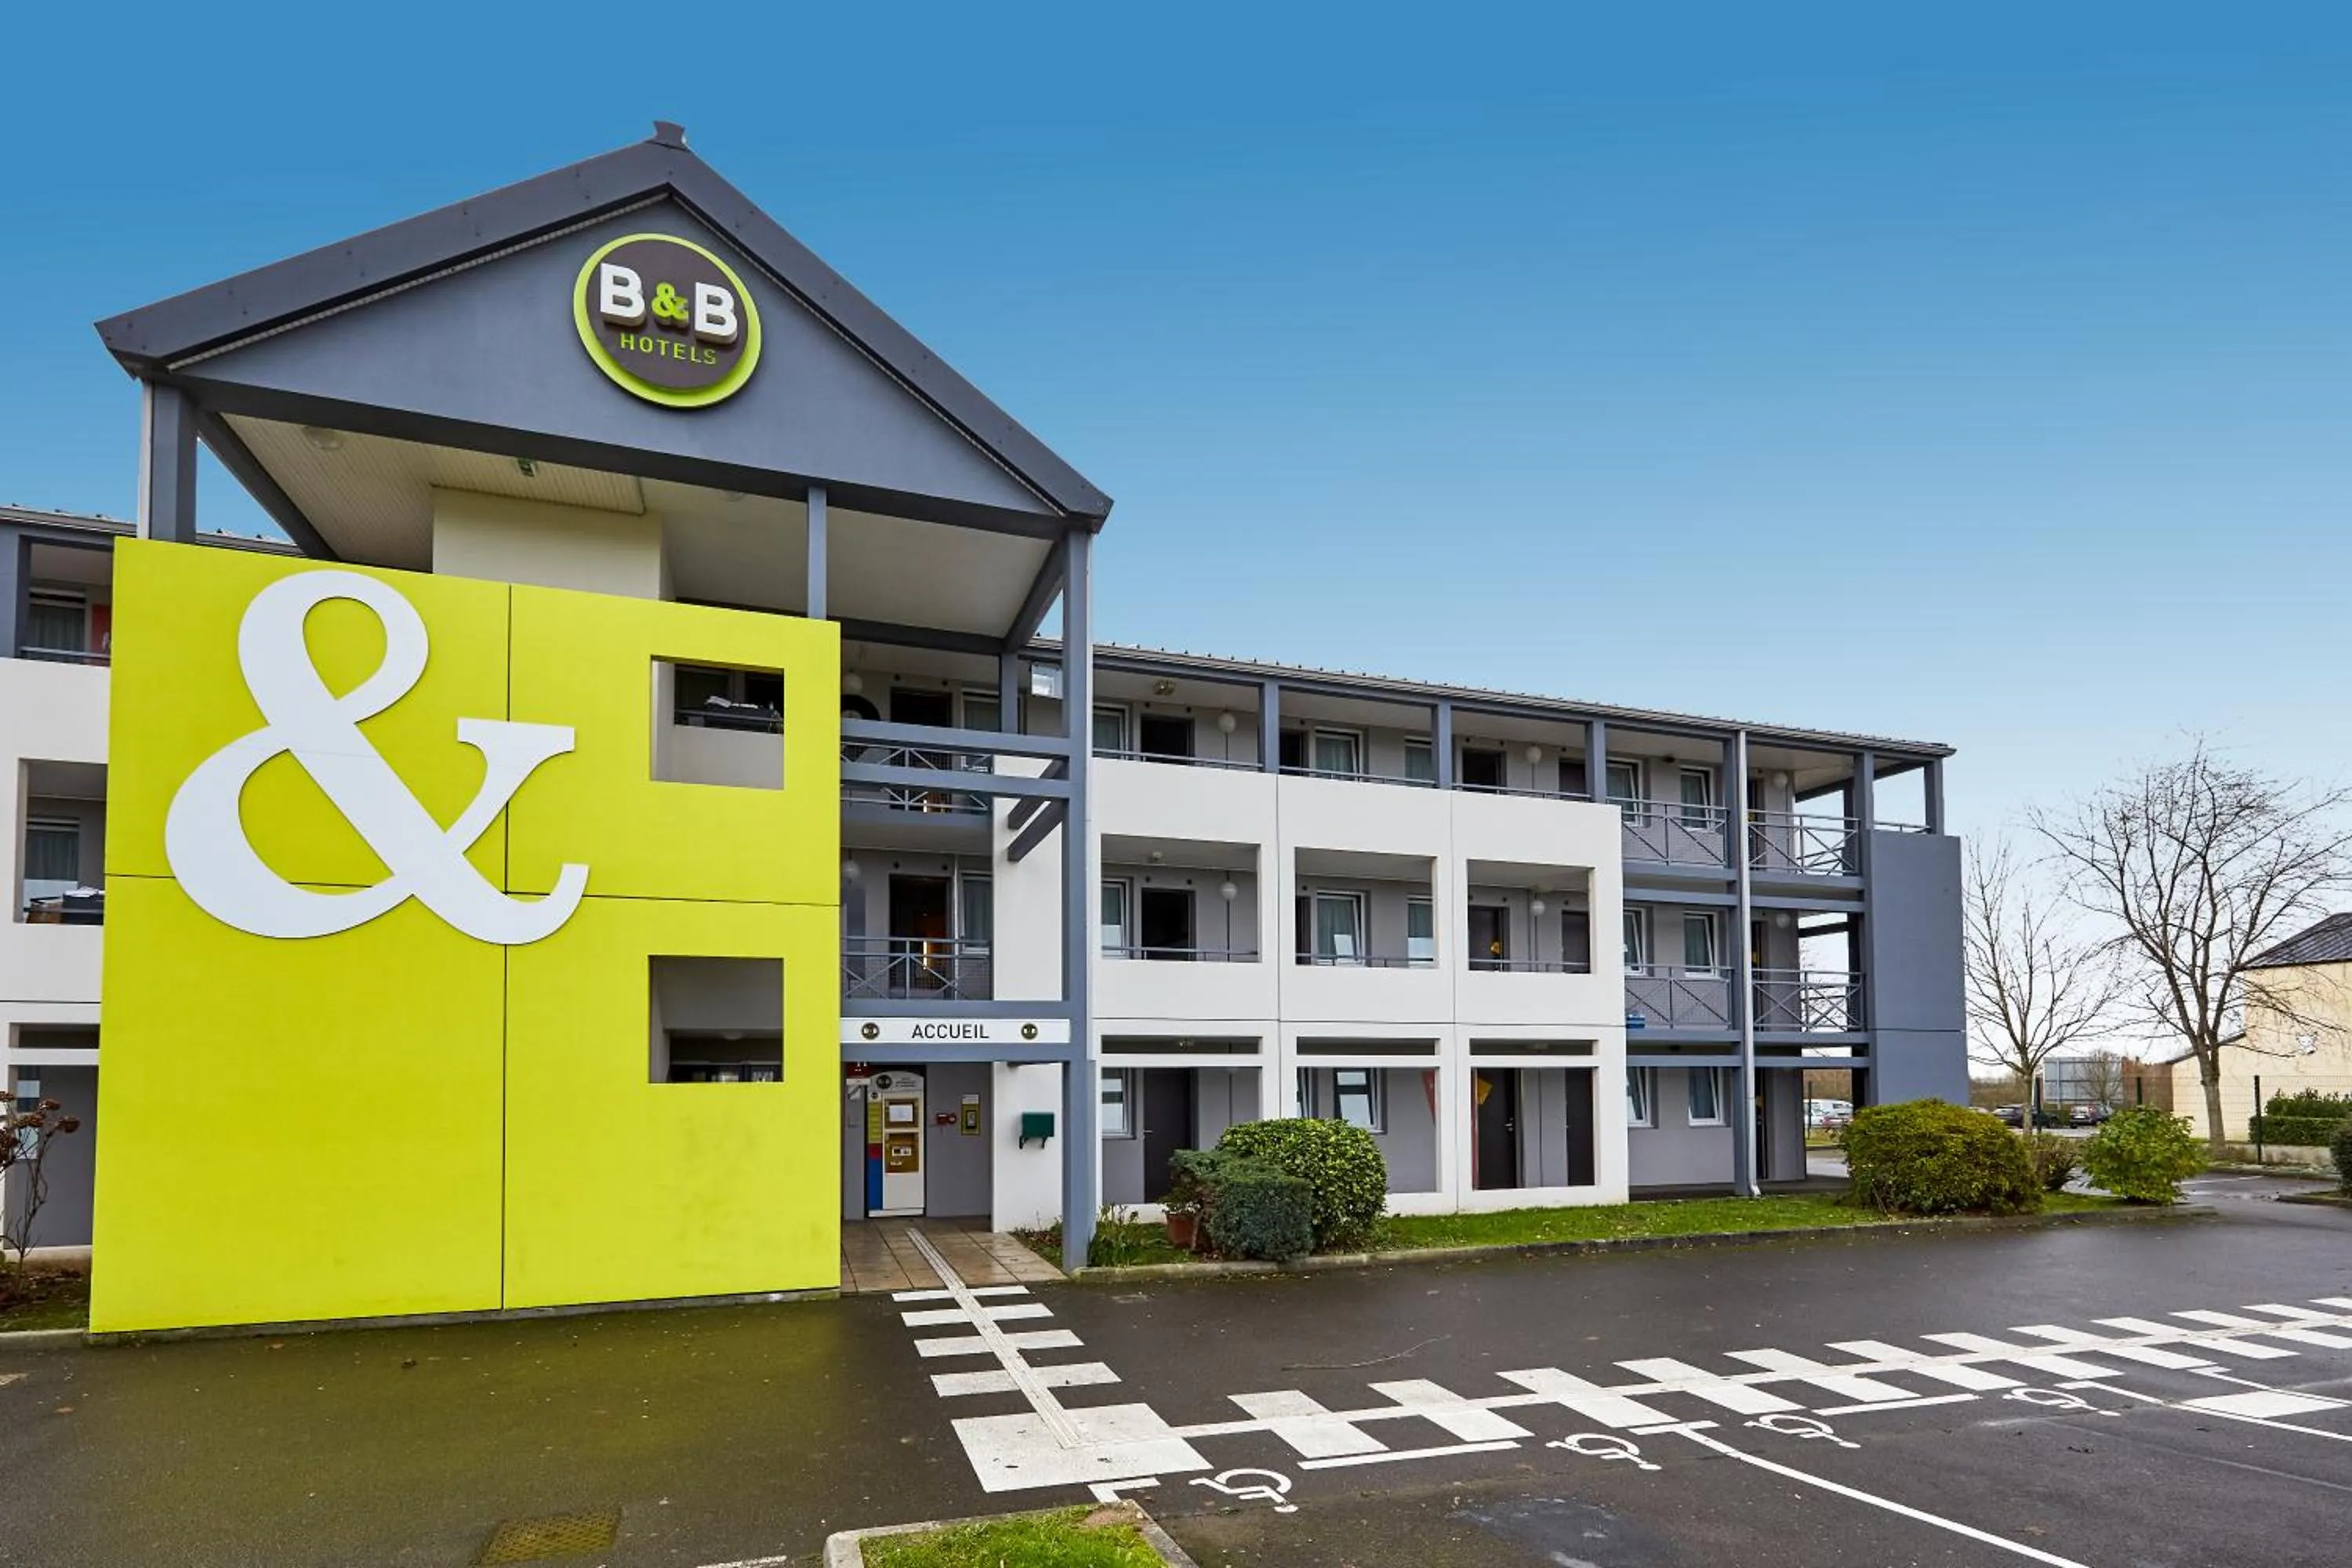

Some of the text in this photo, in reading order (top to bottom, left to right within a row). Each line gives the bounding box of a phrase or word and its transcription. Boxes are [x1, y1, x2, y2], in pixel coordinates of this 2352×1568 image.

[600, 263, 738, 342] B&B
[619, 332, 717, 365] HOTELS
[165, 569, 590, 945] &
[911, 1023, 990, 1040] ACCUEIL
